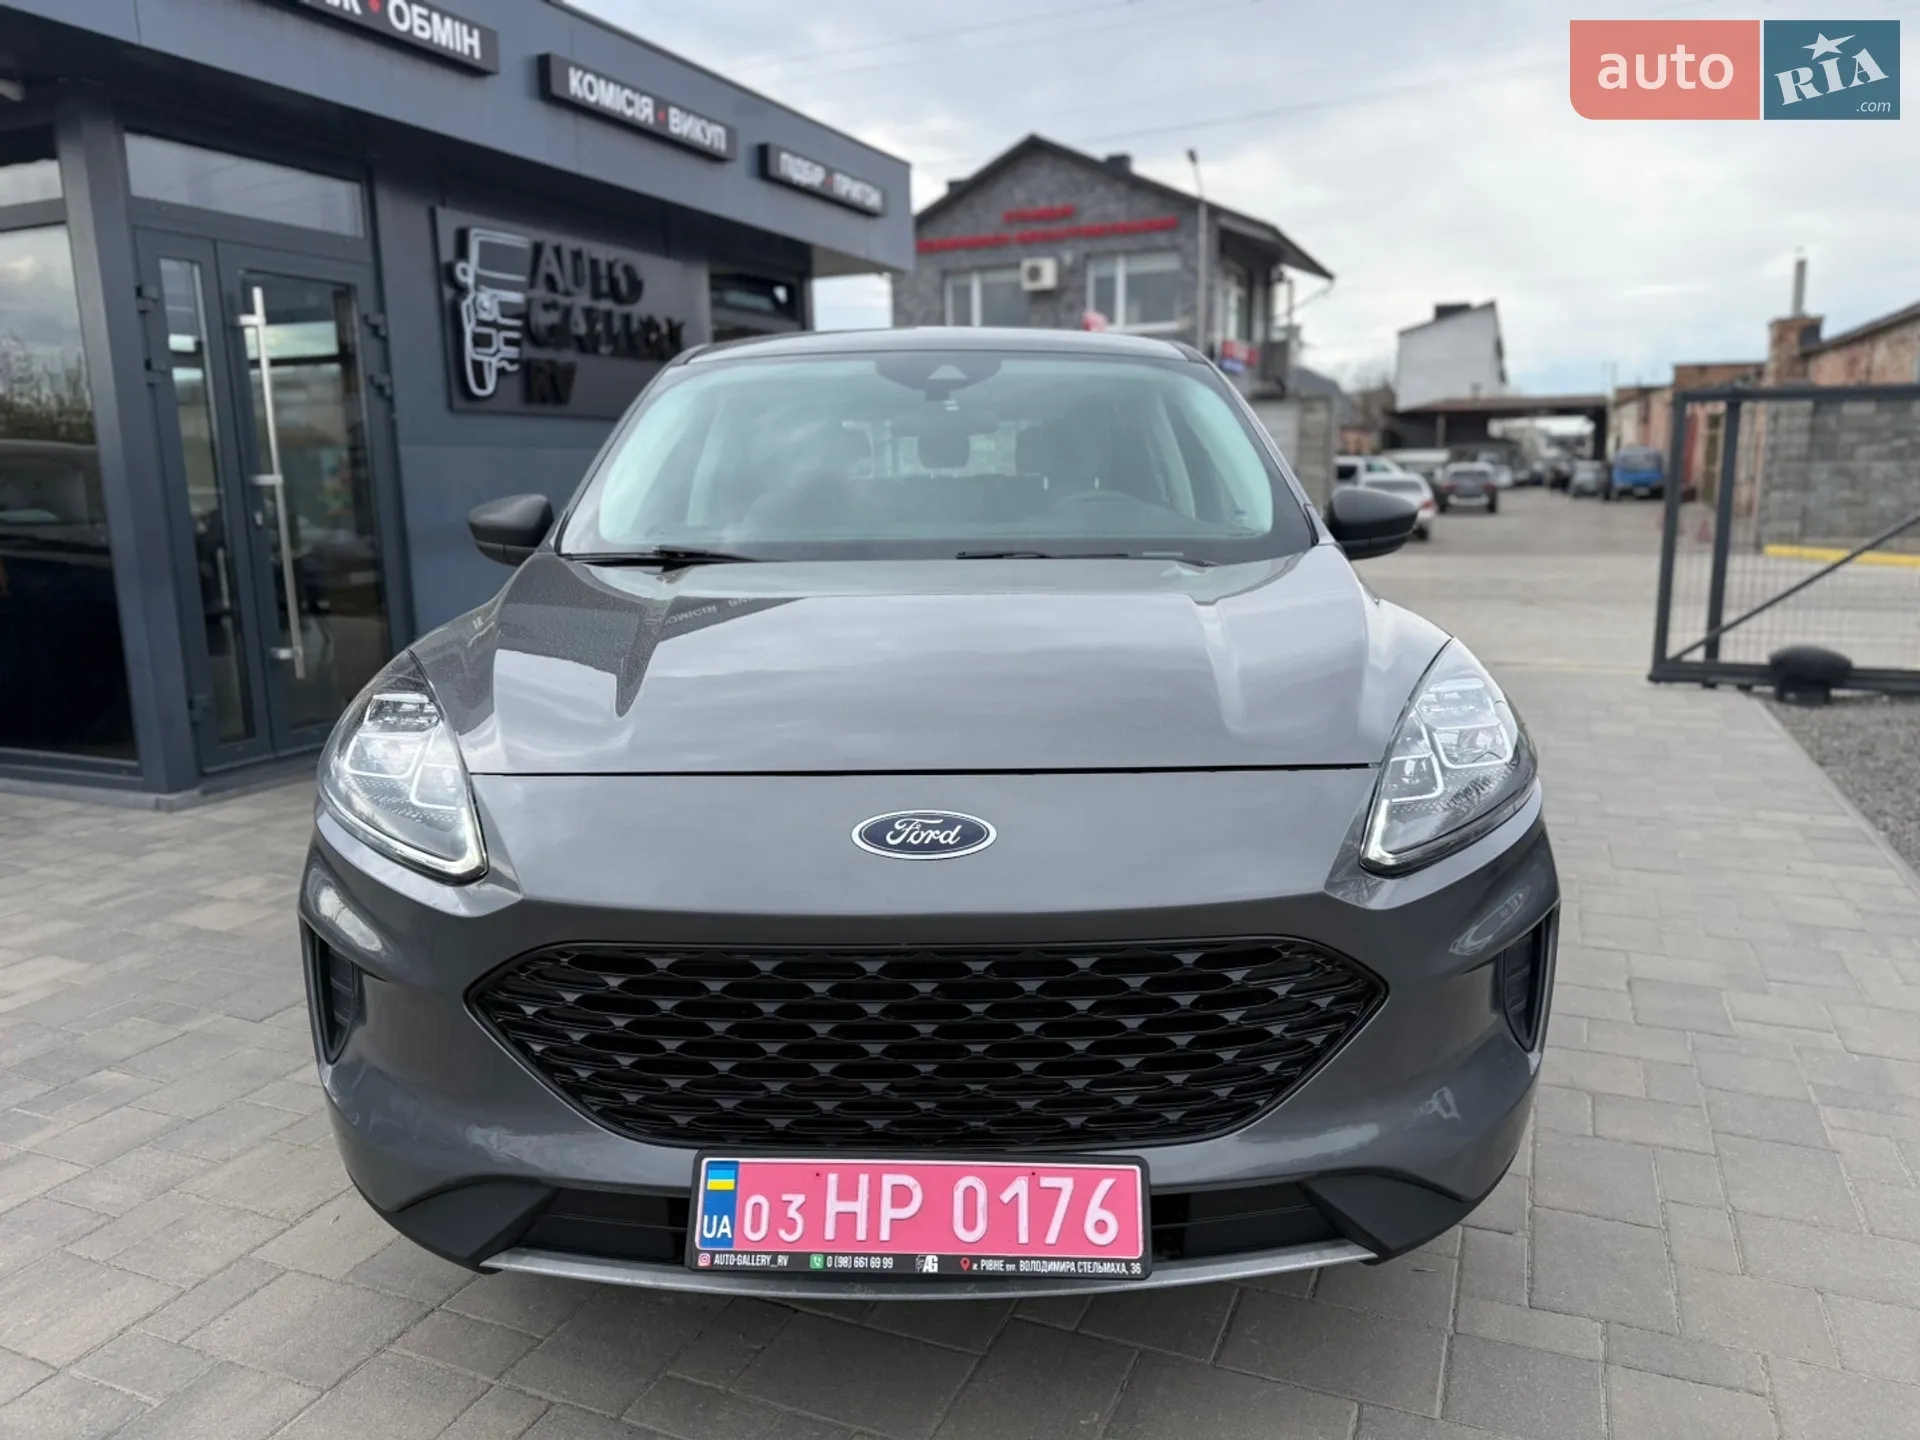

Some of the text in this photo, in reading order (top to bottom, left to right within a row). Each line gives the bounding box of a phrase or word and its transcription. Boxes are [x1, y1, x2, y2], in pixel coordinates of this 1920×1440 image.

[387, 0, 481, 60] ОБМІН
[568, 65, 727, 152] КОМІСІЯ ВИКУП
[528, 239, 645, 306] AUTO
[885, 818, 962, 845] Ford
[743, 1193, 806, 1243] 03
[952, 1175, 1119, 1246] 0176
[703, 1214, 732, 1239] UA
[713, 1253, 789, 1267] AUTO-GALLERY_RV
[853, 1256, 868, 1268] 661
[882, 1257, 893, 1269] 99
[980, 1259, 1005, 1271] РІВНЕ
[1019, 1260, 1077, 1273] ВОЛОДИМИРА
